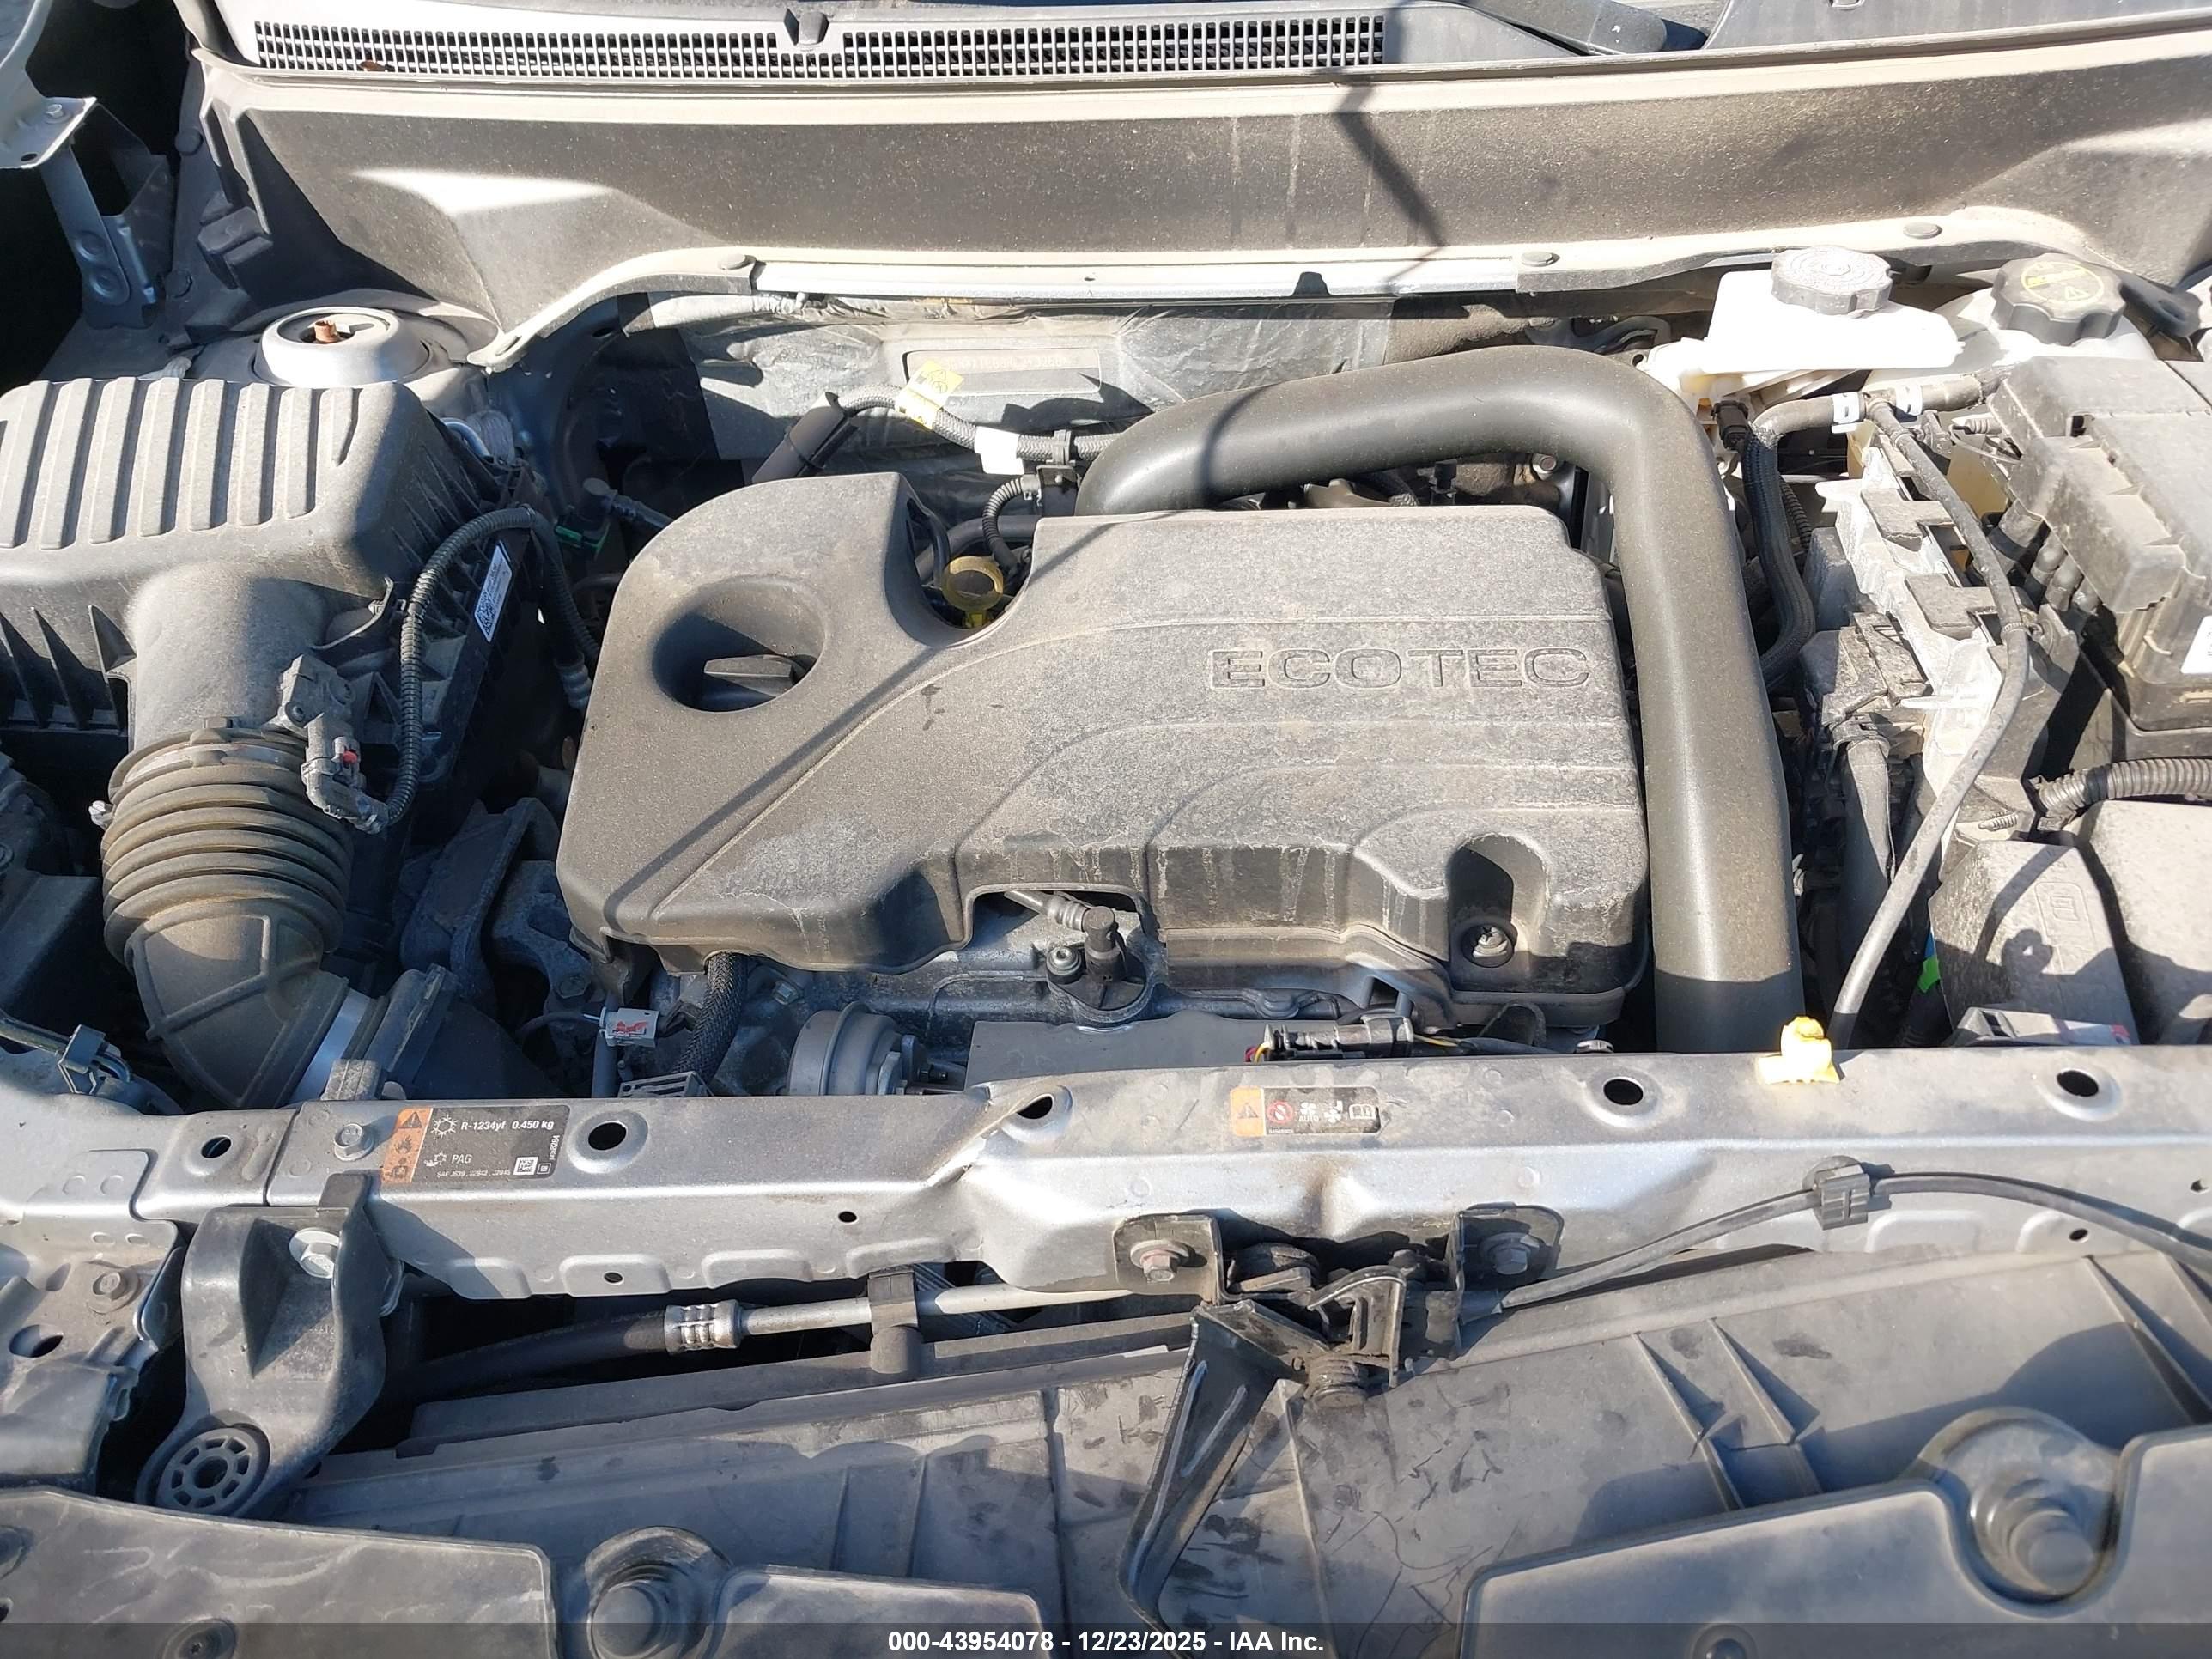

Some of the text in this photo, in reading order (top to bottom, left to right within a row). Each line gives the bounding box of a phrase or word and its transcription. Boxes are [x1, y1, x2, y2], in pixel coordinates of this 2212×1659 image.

[1209, 647, 1590, 688] ECOTEC
[460, 1120, 555, 1132] R-1234yf 0.450 kg
[451, 1153, 473, 1164] PAG
